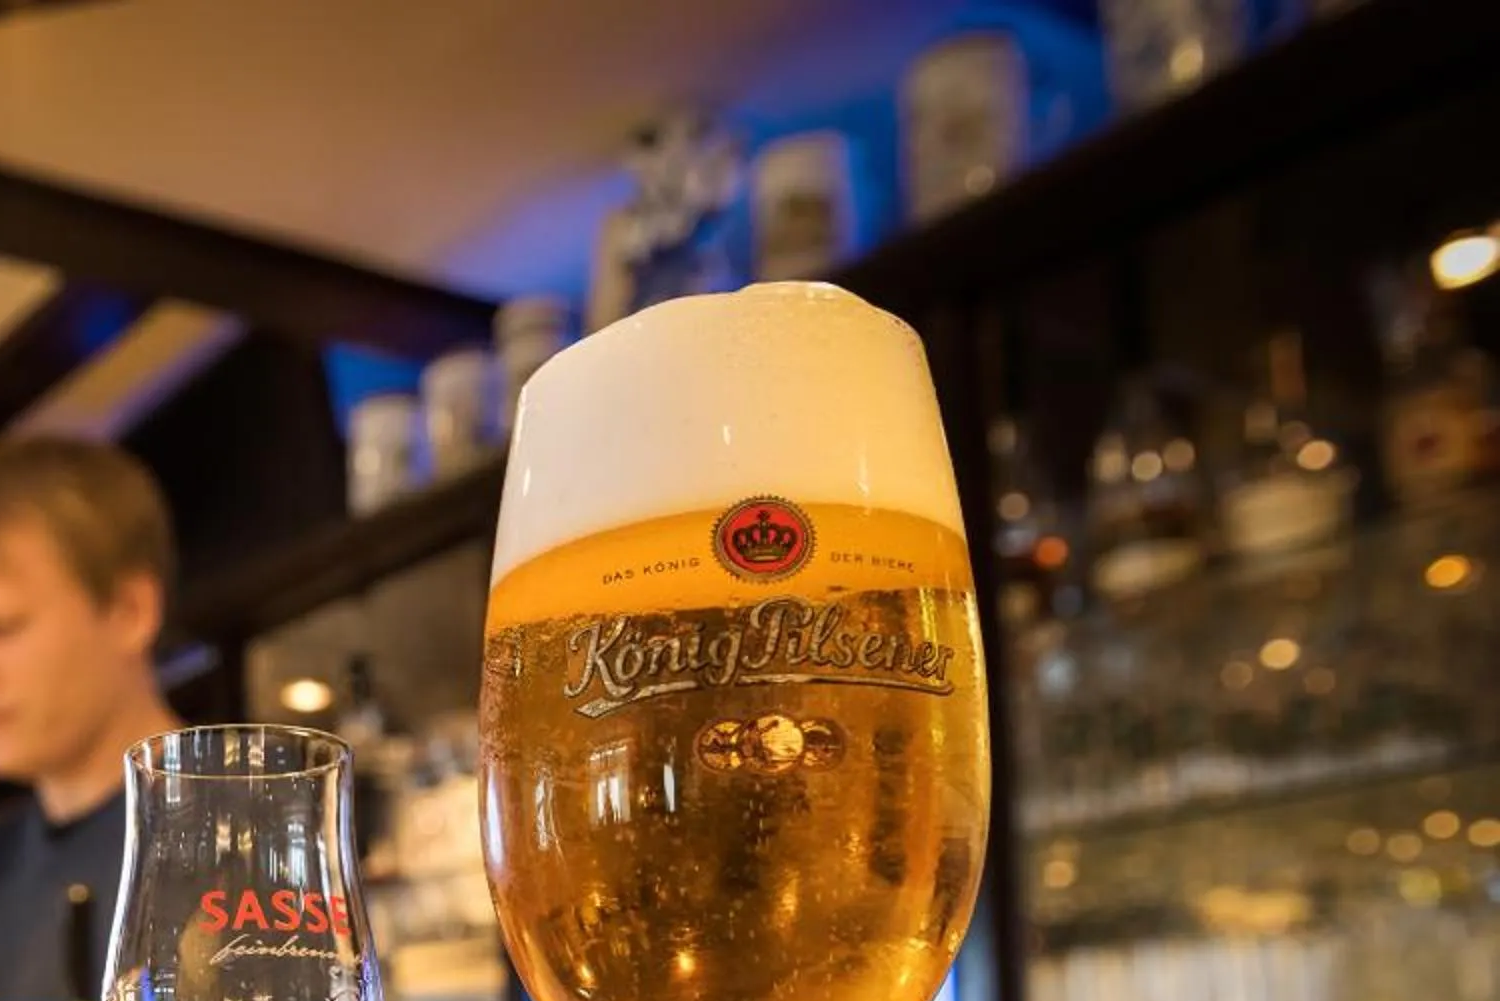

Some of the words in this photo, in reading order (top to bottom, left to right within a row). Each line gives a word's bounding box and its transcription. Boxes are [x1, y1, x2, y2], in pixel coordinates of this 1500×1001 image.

[602, 569, 635, 585] DAS
[643, 557, 701, 576] KÖNIG
[830, 551, 863, 563] DER
[564, 612, 743, 700] König
[740, 598, 956, 683] Pilsener
[199, 889, 351, 936] SASSE
